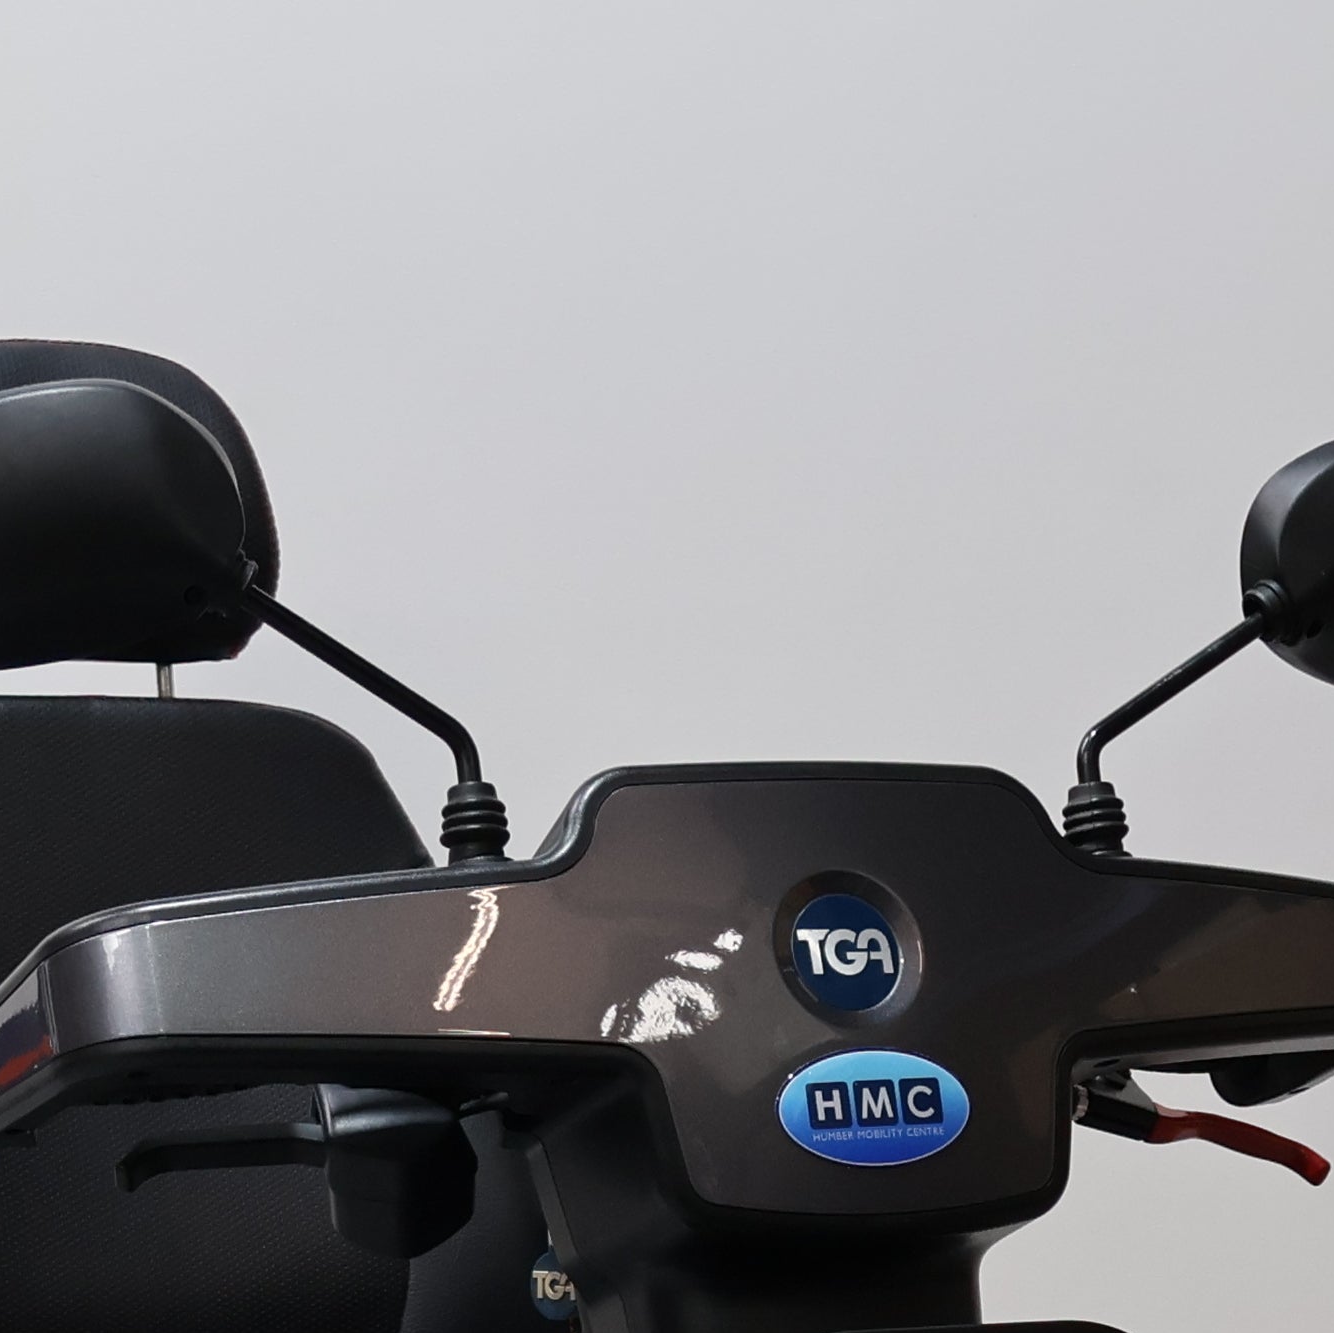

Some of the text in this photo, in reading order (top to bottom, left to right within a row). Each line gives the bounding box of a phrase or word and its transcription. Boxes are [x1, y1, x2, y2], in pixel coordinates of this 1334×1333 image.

[795, 928, 895, 976] TGA
[814, 1085, 935, 1121] HMC
[812, 1126, 946, 1142] HUMBER MOBILITY CENTRE
